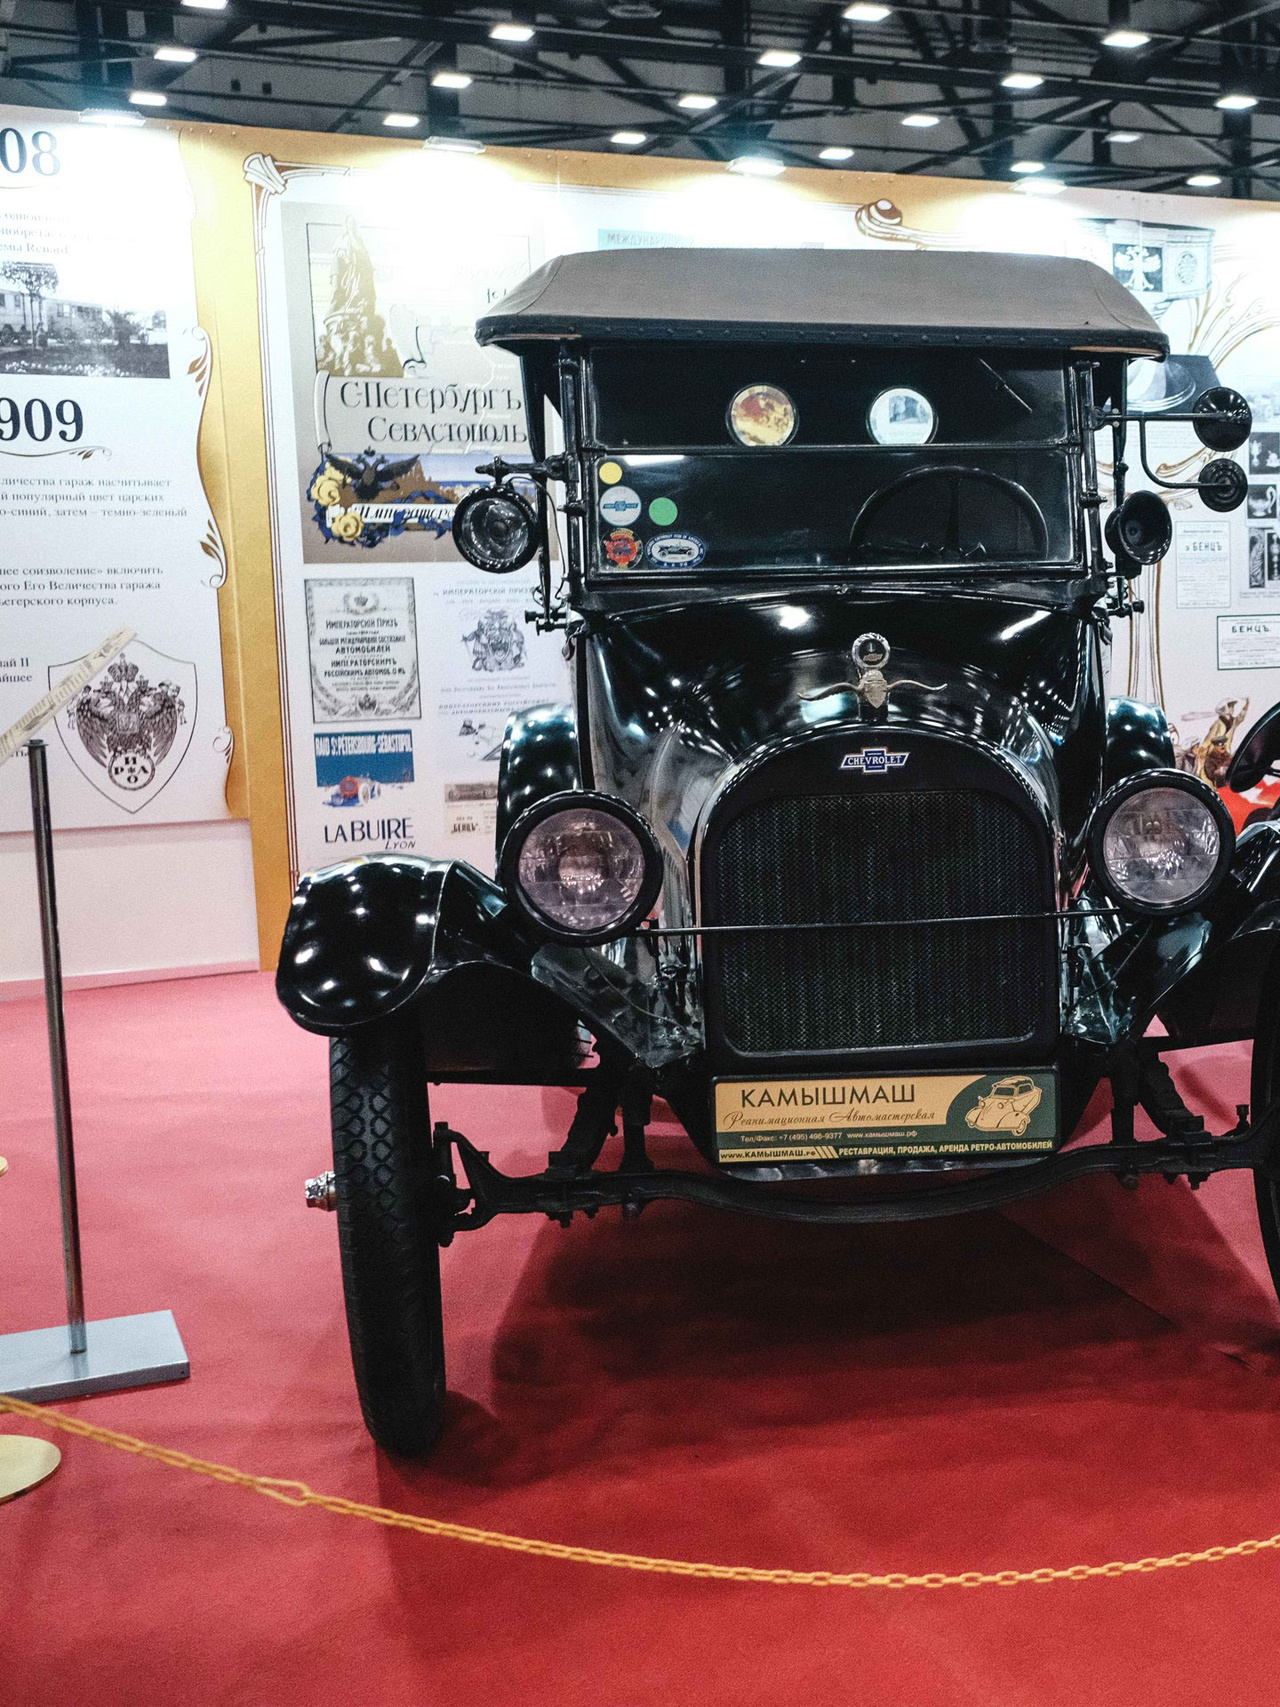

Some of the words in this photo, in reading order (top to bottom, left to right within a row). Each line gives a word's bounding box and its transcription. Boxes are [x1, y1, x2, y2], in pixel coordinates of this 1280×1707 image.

[0, 397, 84, 443] 909
[847, 755, 903, 766] CHEVROLET
[324, 824, 348, 843] LA
[350, 817, 414, 842] BUIRE
[741, 1084, 915, 1108] КАМЫШМАШ
[723, 1110, 825, 1130] Реанимационная
[829, 1107, 935, 1124] Автомастерская
[839, 1146, 896, 1156] РЕСТАВРАЦИЯ,
[897, 1145, 938, 1155] ПРОДАЖА,
[938, 1144, 969, 1153] АРЕНДА
[970, 1140, 1053, 1151] РЕТРО-АВТОМОБИЛЕЙ
